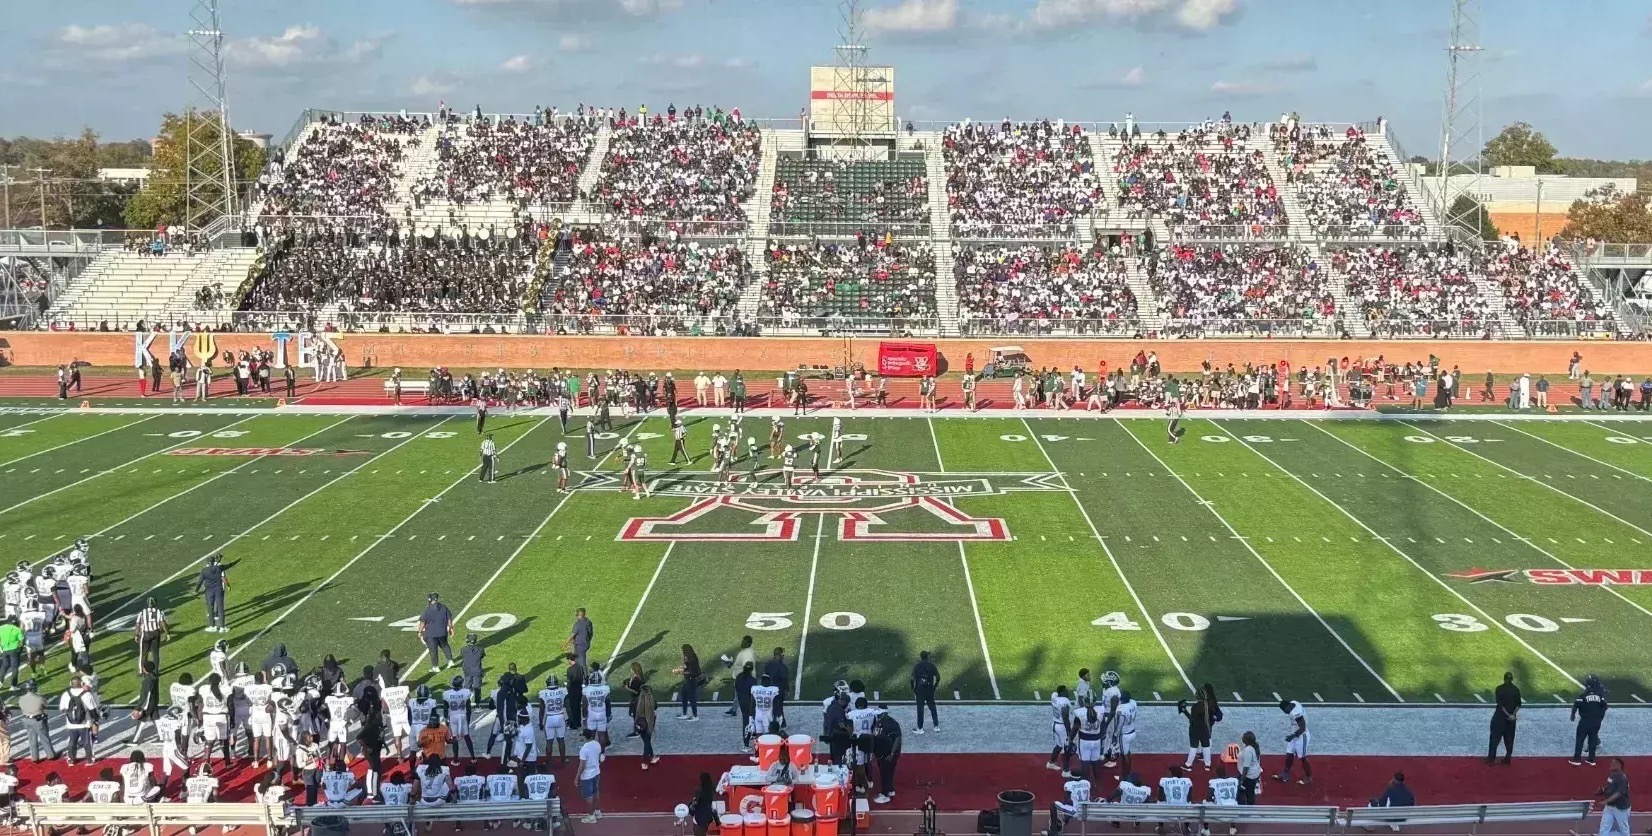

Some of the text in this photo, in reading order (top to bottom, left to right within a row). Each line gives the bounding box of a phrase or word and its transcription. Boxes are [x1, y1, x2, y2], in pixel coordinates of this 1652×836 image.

[673, 484, 972, 496] MISSISSIPPI VALLEY STATE
[1523, 569, 1652, 585] SW
[745, 612, 866, 631] 50
[1091, 612, 1211, 631] 40
[1431, 613, 1560, 632] 30
[1228, 746, 1240, 760] 40
[460, 785, 479, 801] 32
[493, 781, 506, 796] 11
[529, 782, 547, 794] 15
[1172, 786, 1182, 800] 6
[1220, 788, 1236, 800] 31
